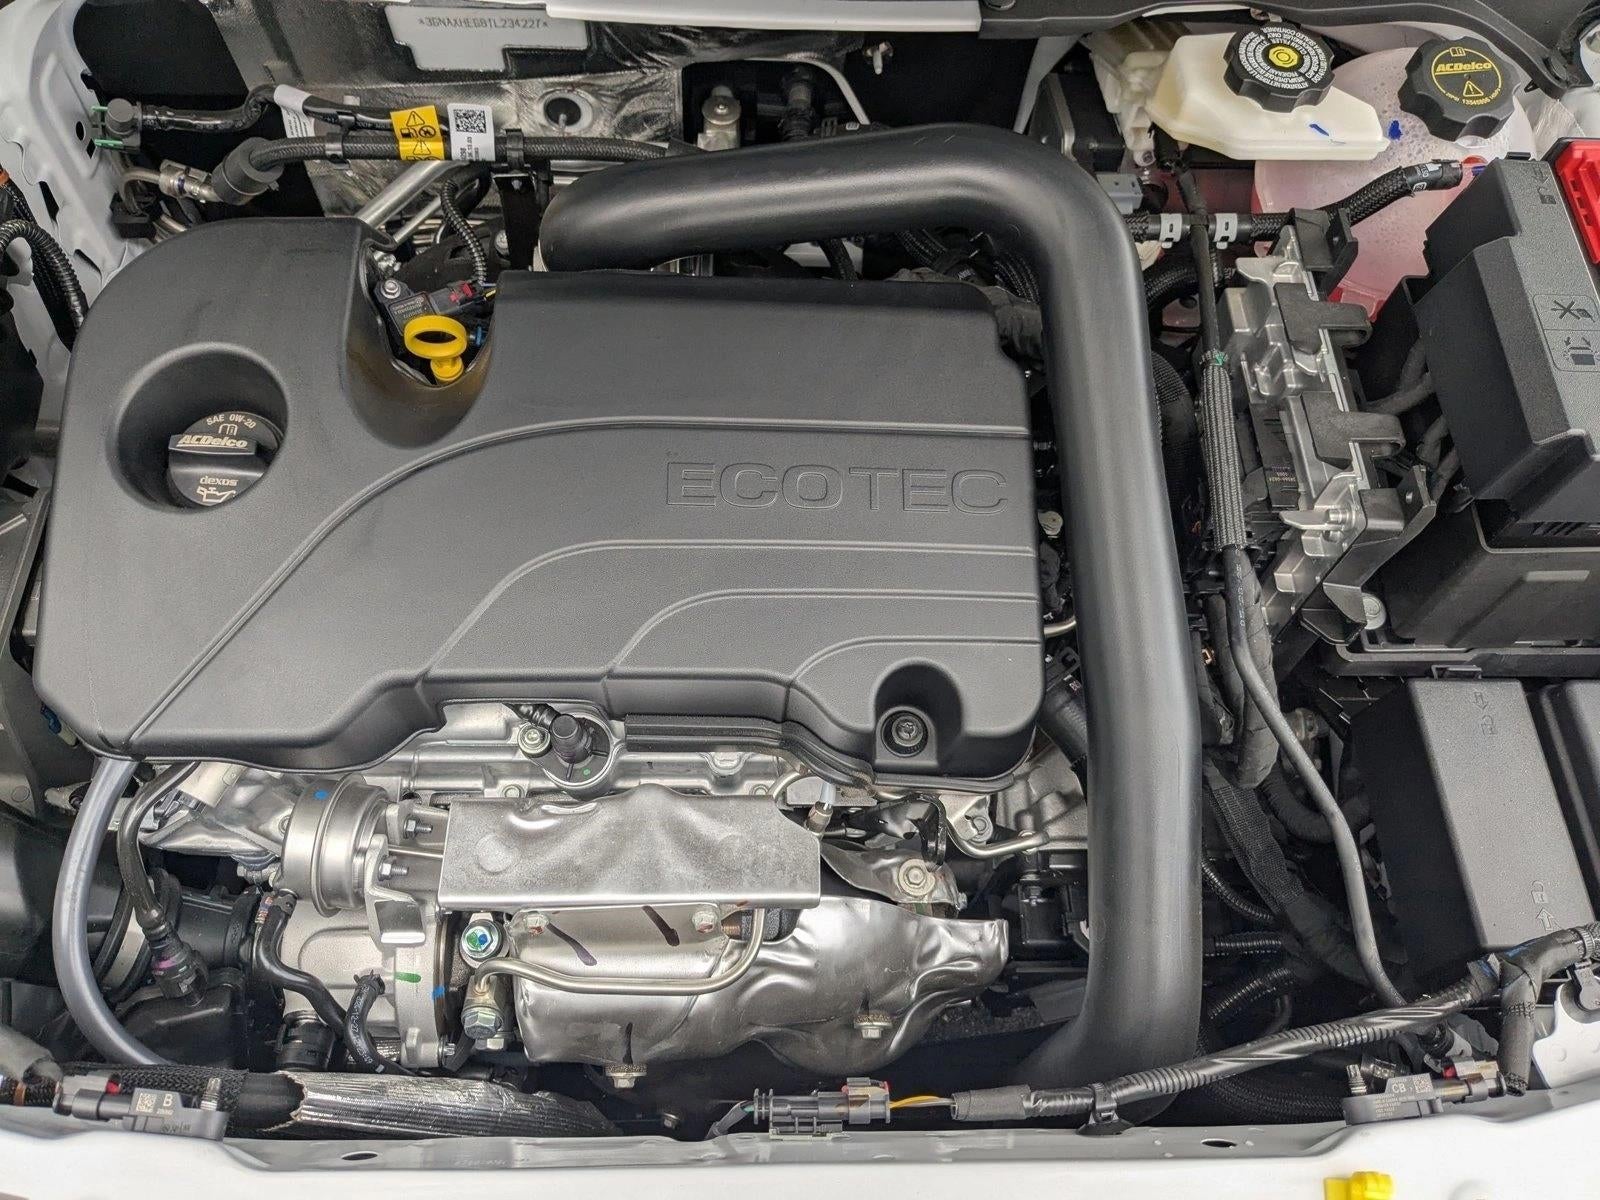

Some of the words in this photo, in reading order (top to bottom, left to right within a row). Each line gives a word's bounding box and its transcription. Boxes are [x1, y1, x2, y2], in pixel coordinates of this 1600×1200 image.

[1436, 62, 1492, 72] ACDelco
[206, 414, 225, 425] SAE
[229, 413, 257, 429] 0W-20
[178, 434, 248, 448] ACDelco
[199, 475, 239, 487] dexos
[666, 461, 1009, 516] ECOTEC
[1391, 1083, 1407, 1094] CB
[163, 1093, 173, 1107] B
